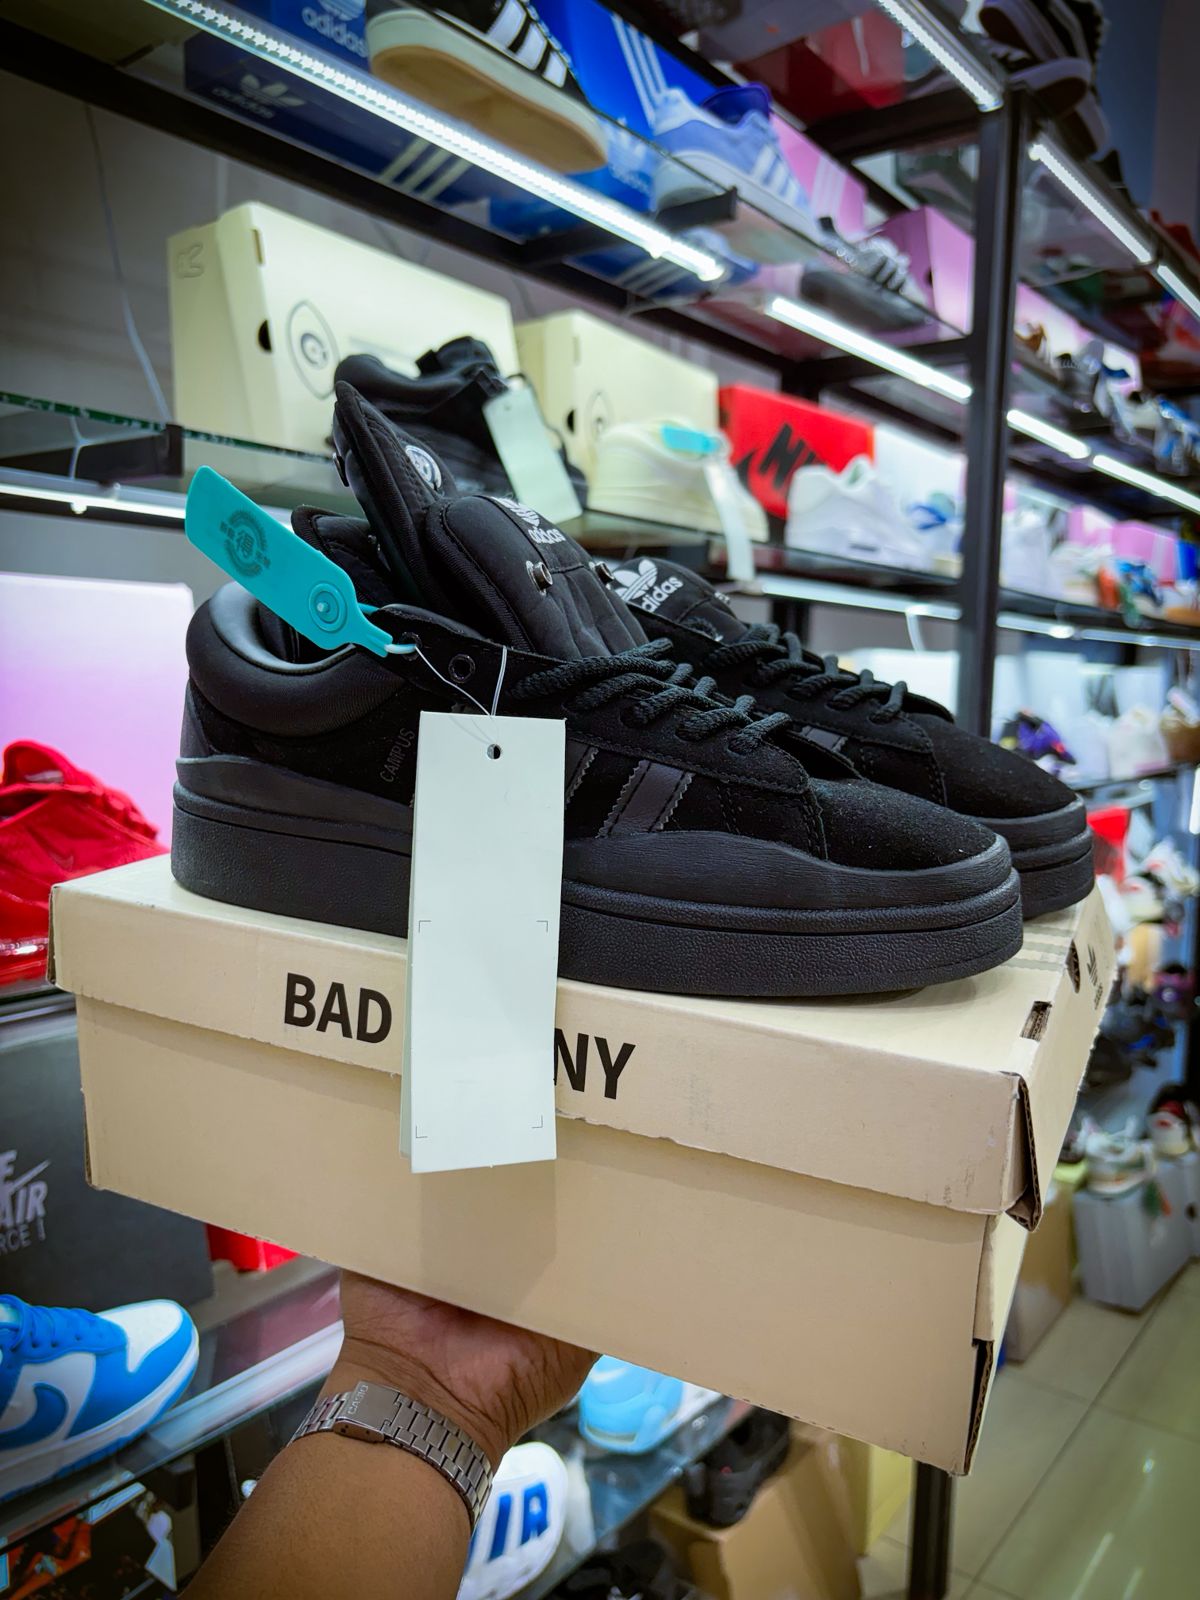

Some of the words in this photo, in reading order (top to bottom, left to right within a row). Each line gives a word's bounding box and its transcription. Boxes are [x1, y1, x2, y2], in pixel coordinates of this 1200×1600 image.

[302, 6, 369, 58] adidas
[641, 577, 684, 613] didas
[380, 727, 415, 783] CAMPUS
[284, 972, 393, 1044] BAD
[347, 1384, 369, 1415] CASIO
[466, 1481, 550, 1568] IR
